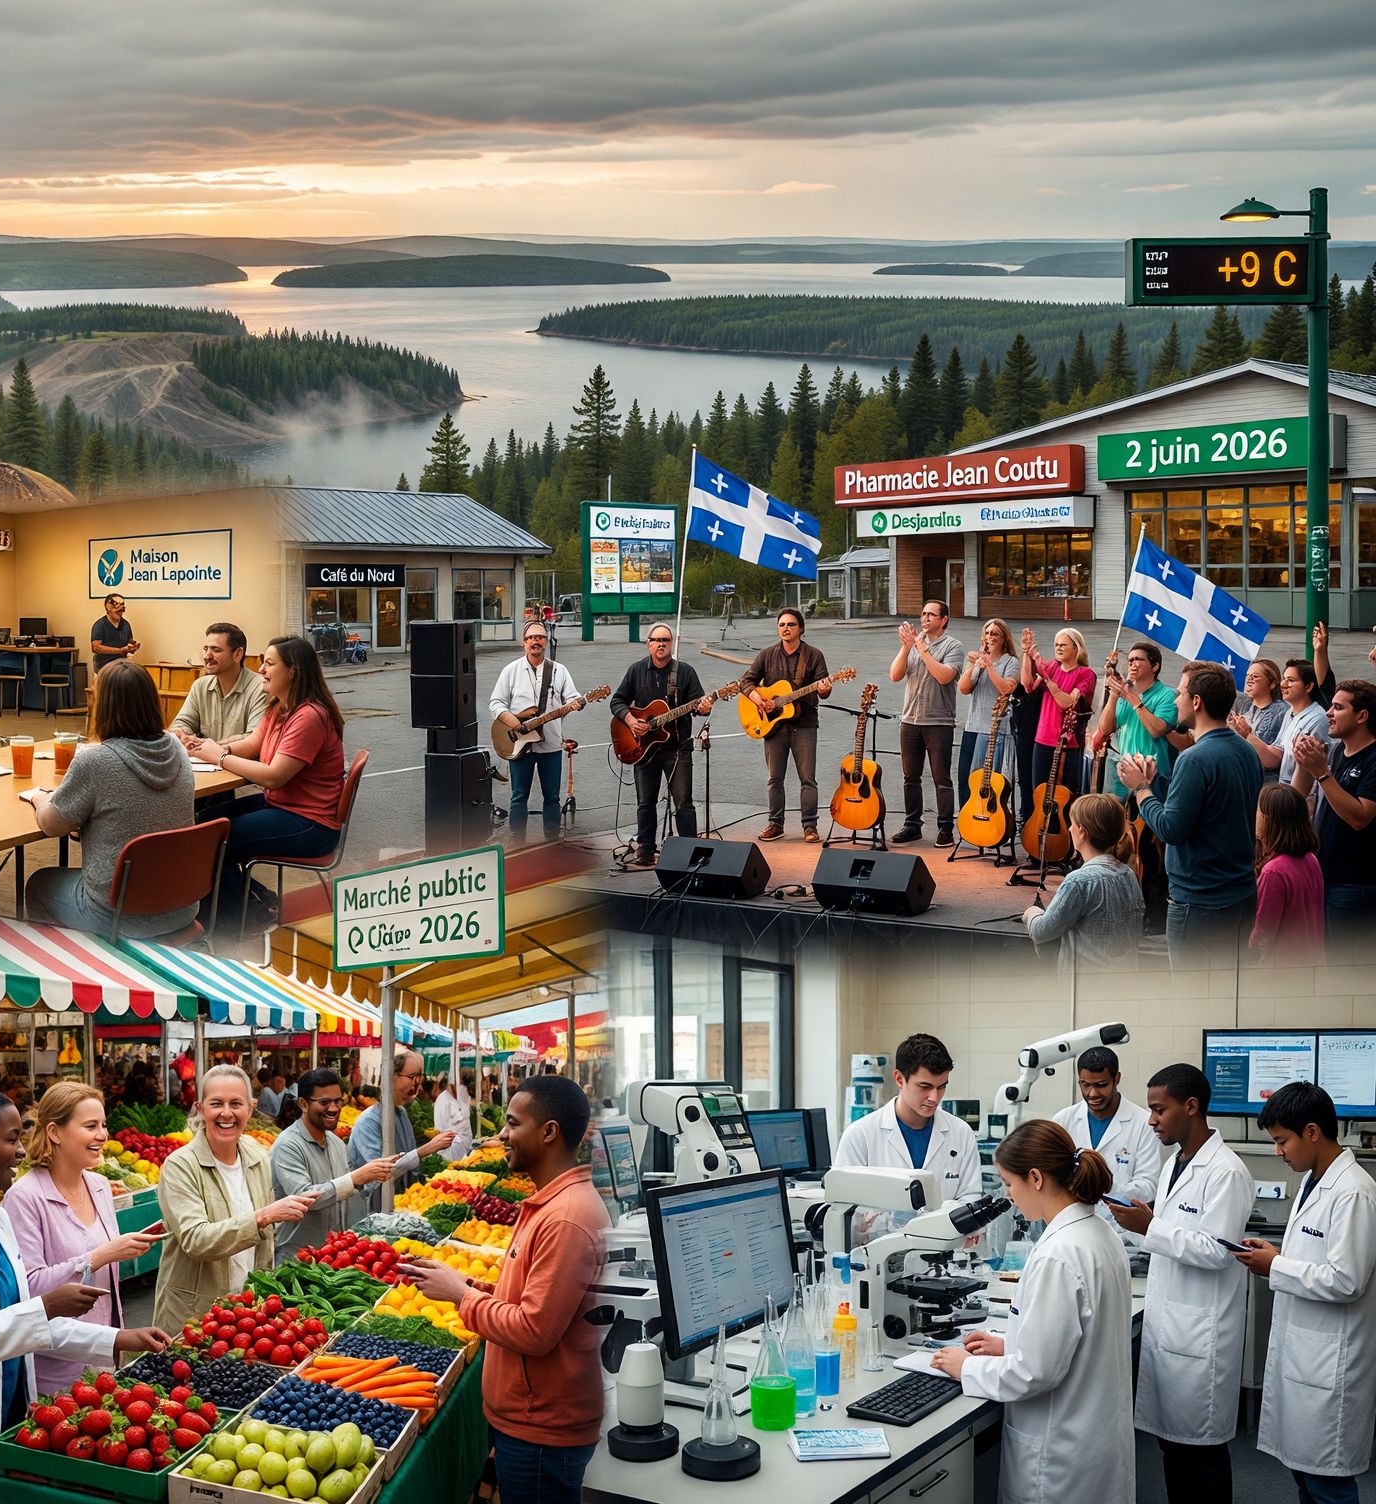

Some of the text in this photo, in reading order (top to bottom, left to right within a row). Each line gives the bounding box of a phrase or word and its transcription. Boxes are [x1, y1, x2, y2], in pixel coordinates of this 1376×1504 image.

[1218, 250, 1297, 287] +9 C
[1125, 427, 1288, 473] 2 juin 2026
[844, 455, 1058, 495] Pharmacie Jean Coutu
[130, 548, 179, 564] Maison
[127, 565, 222, 585] Jean Lapointe
[320, 567, 395, 582] Café du Nord
[343, 876, 412, 912] Marché
[419, 910, 481, 945] 2026
